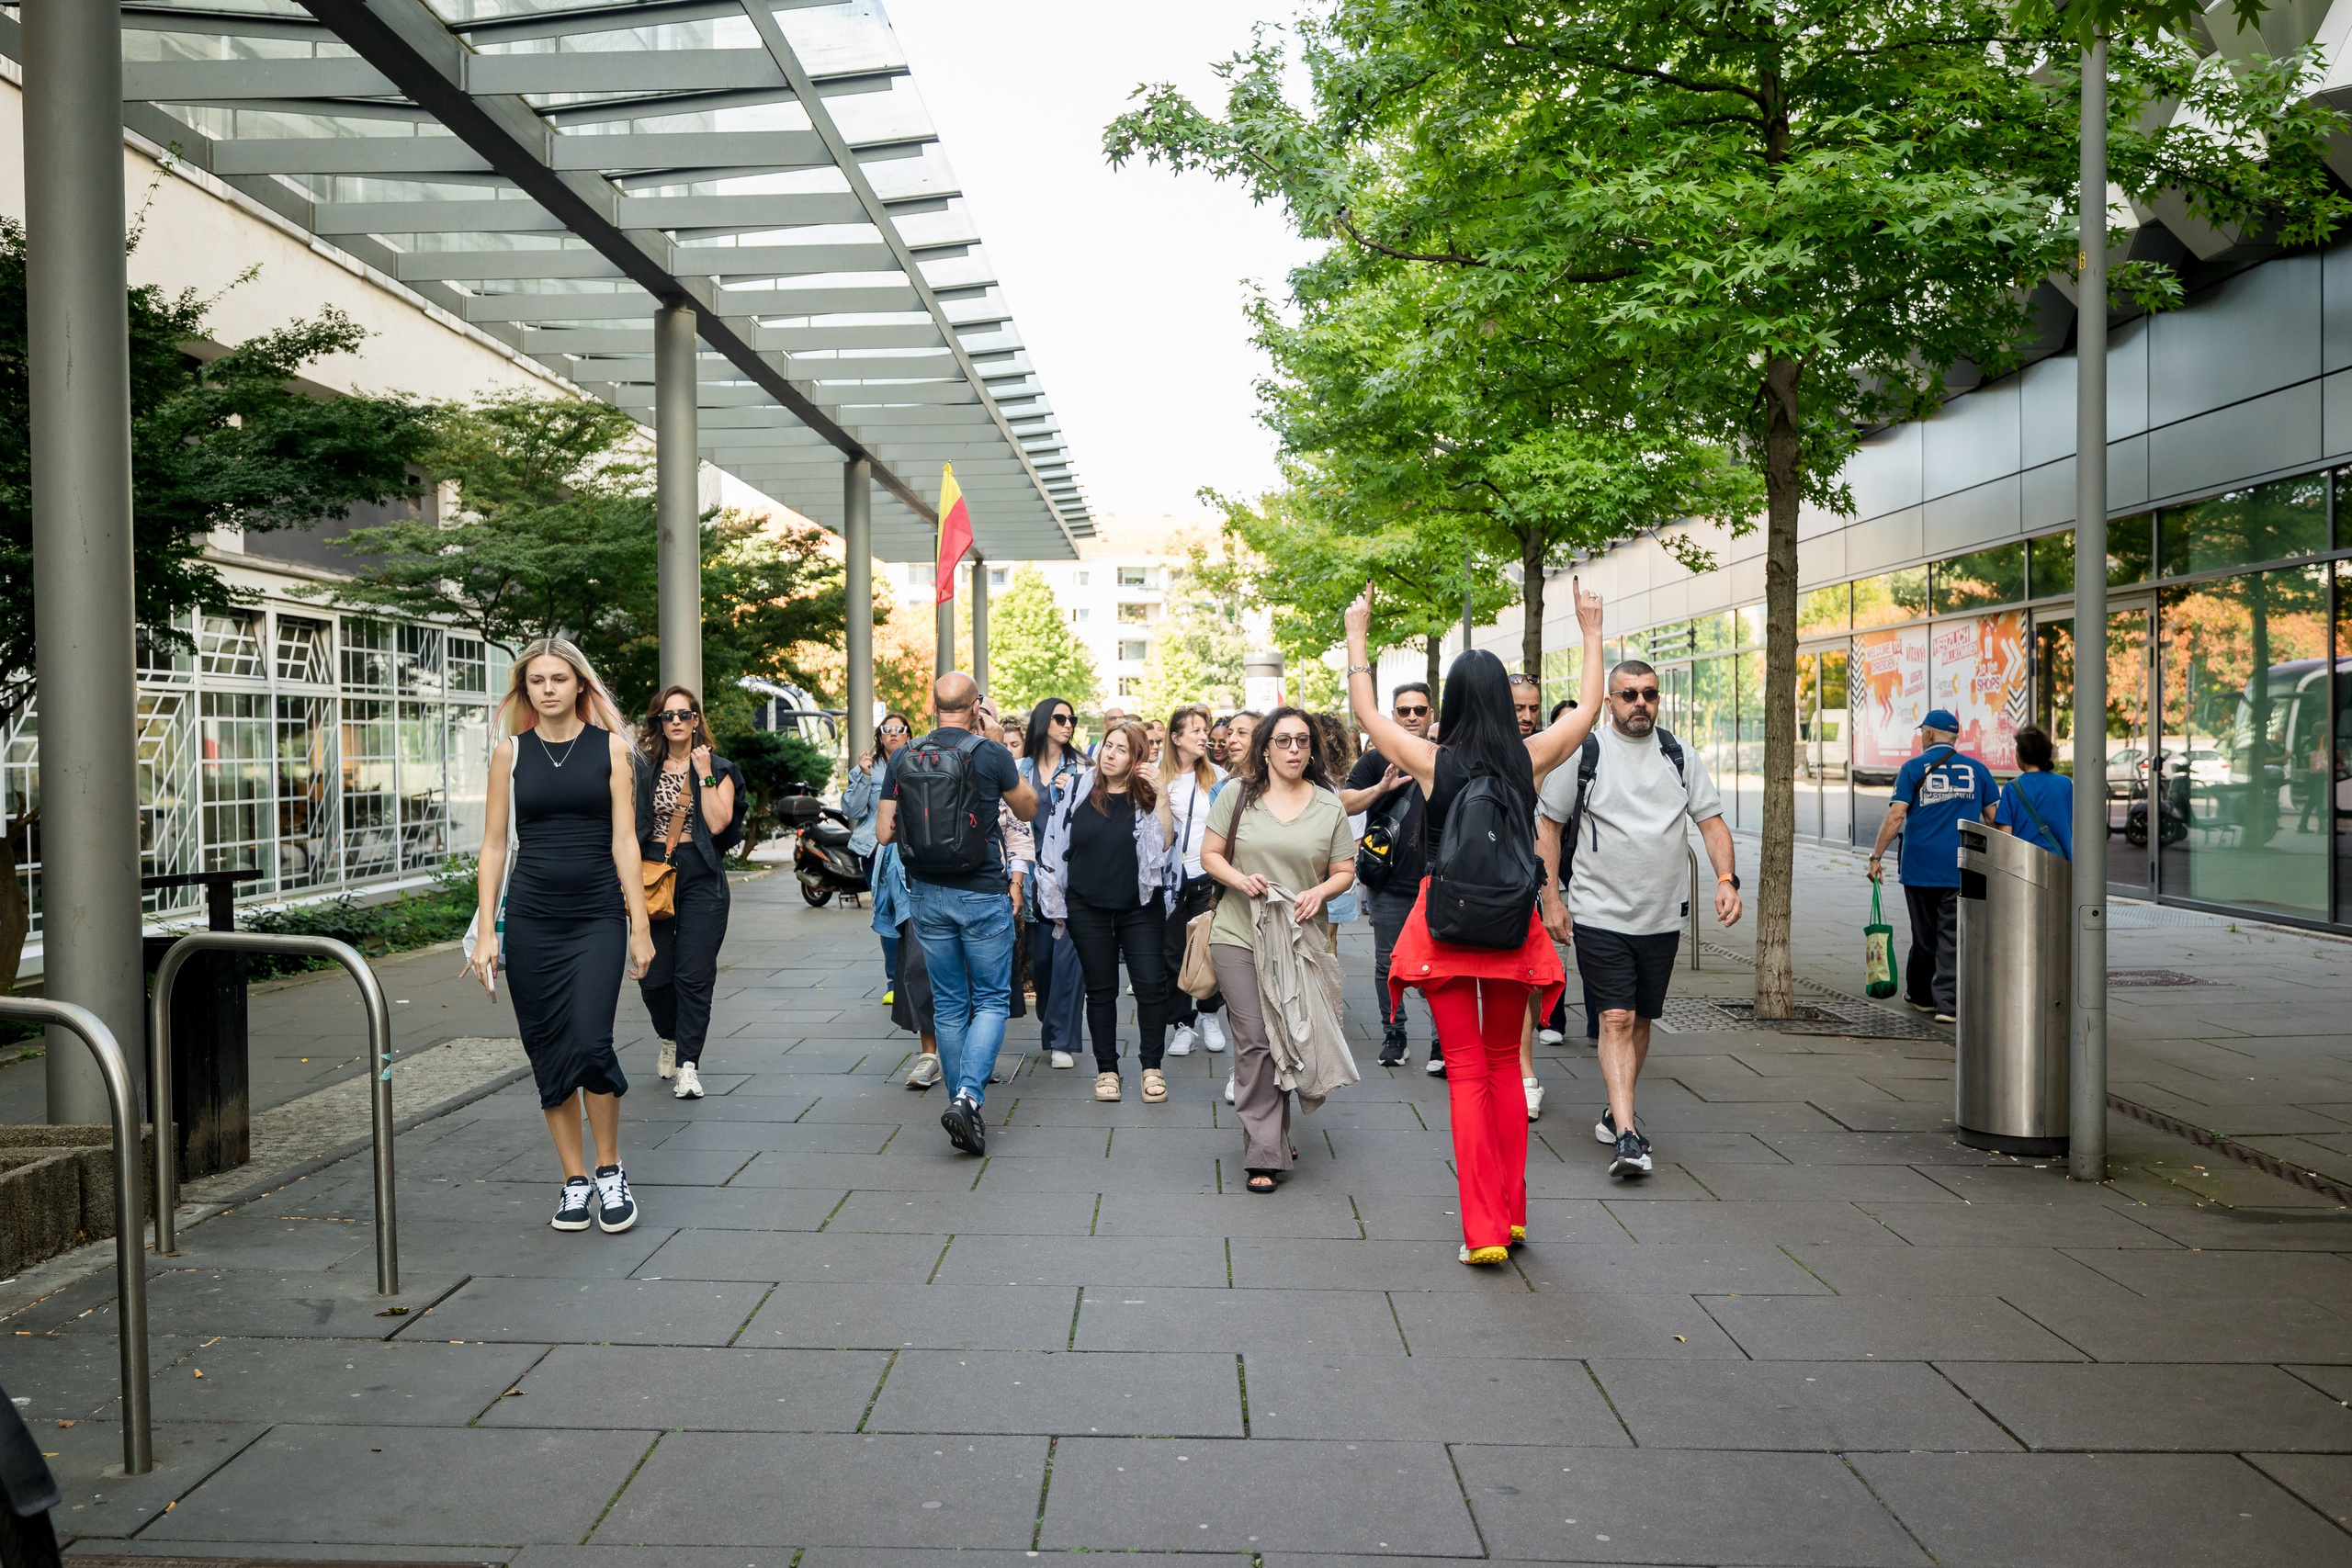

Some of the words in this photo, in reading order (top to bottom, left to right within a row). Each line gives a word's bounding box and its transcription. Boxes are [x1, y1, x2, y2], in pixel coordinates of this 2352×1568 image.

[1867, 643, 1891, 659] WELCOME
[1893, 639, 1902, 654] TO
[1933, 626, 1970, 656] HERZLICH
[1942, 640, 1978, 666] WILLKOMMEN
[1872, 658, 1895, 672] DRESDEN
[1987, 660, 1998, 673] the
[1977, 676, 2000, 692] SHOPS
[1925, 764, 1975, 793] 63
